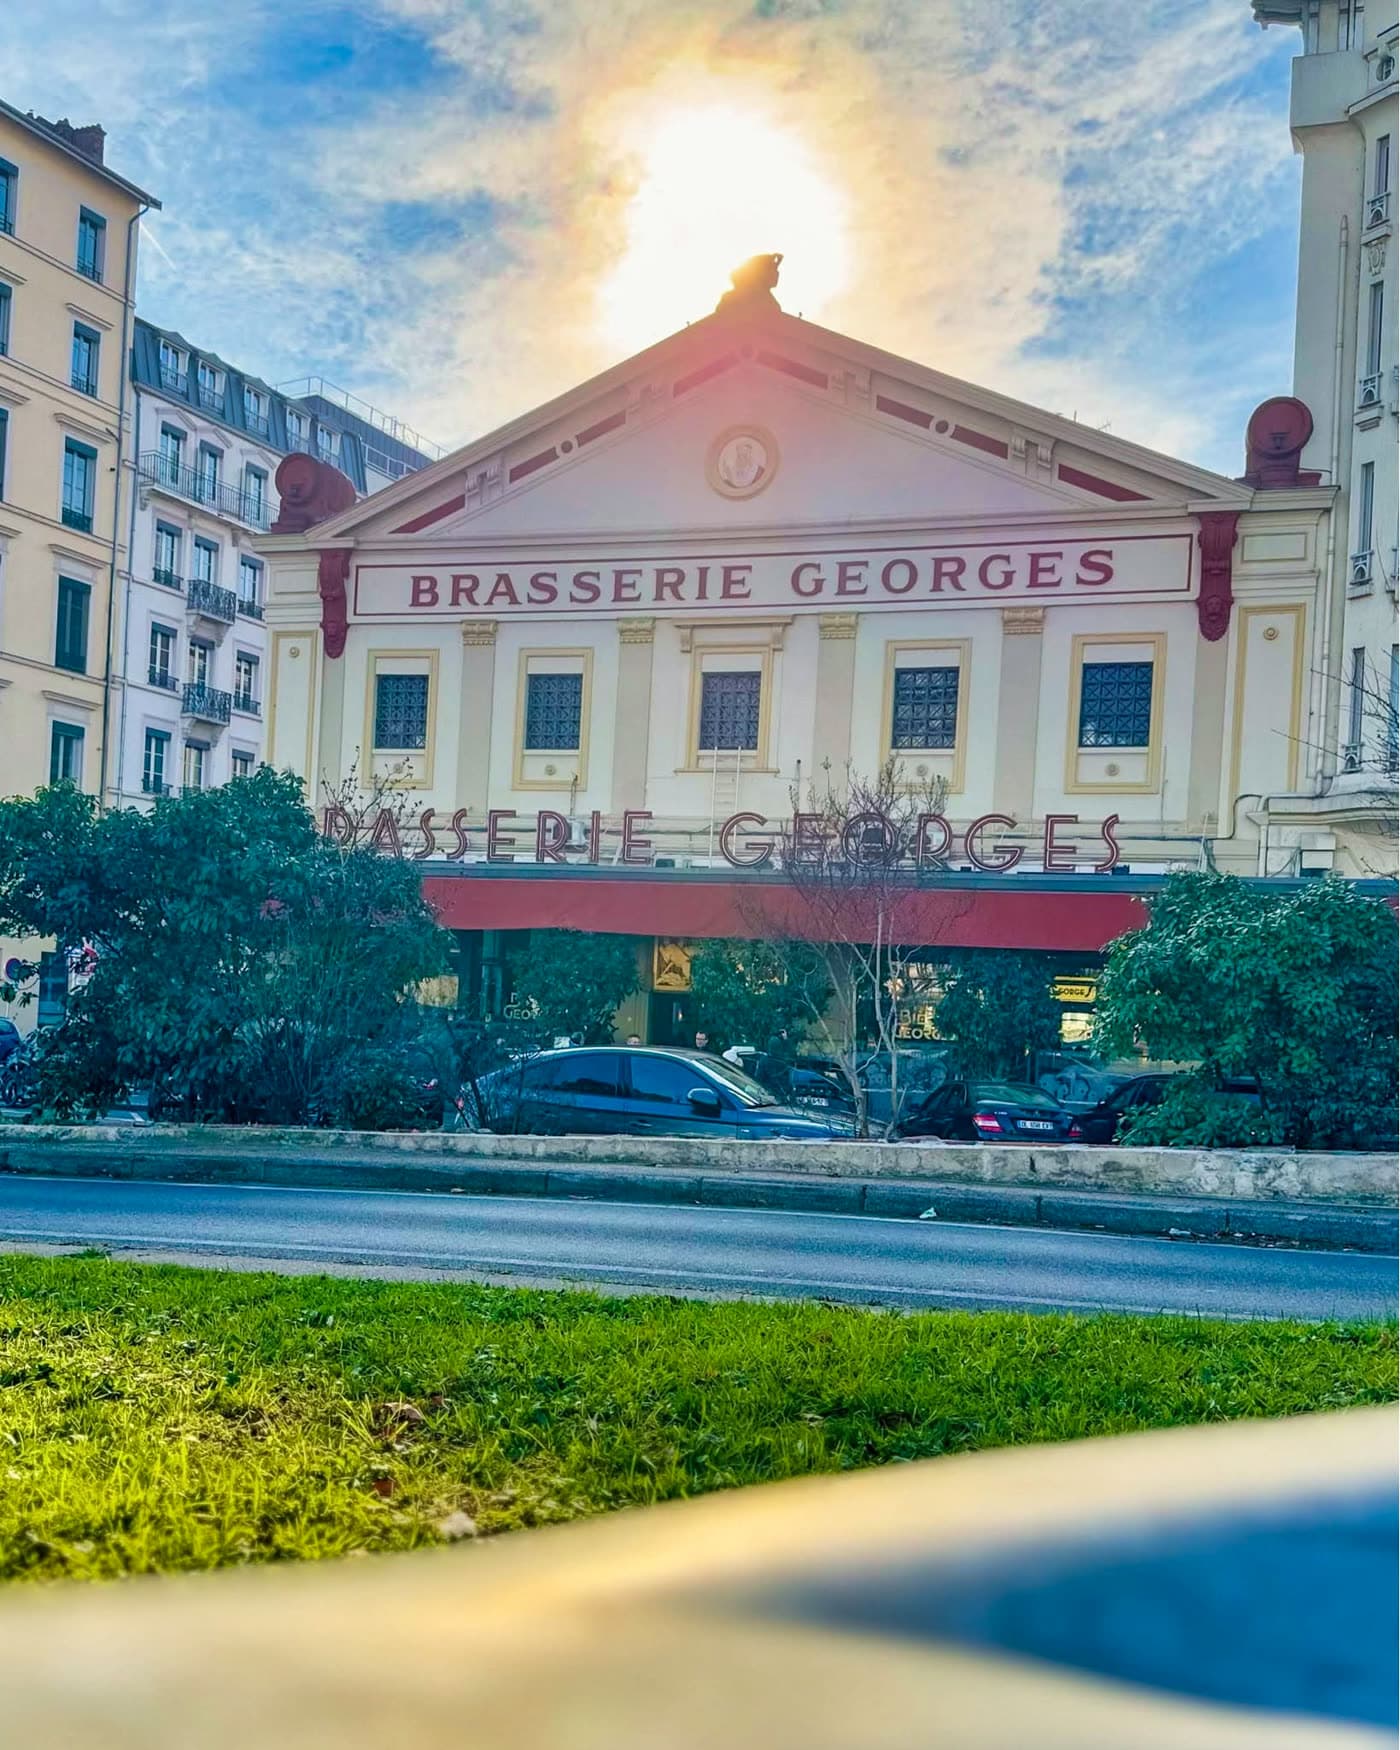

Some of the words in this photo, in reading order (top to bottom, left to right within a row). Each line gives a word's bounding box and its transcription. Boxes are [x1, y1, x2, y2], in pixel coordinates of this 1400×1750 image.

[409, 565, 752, 607] BRASSERIE
[791, 550, 1115, 597] GEORGES
[718, 811, 1120, 873] GEORGES
